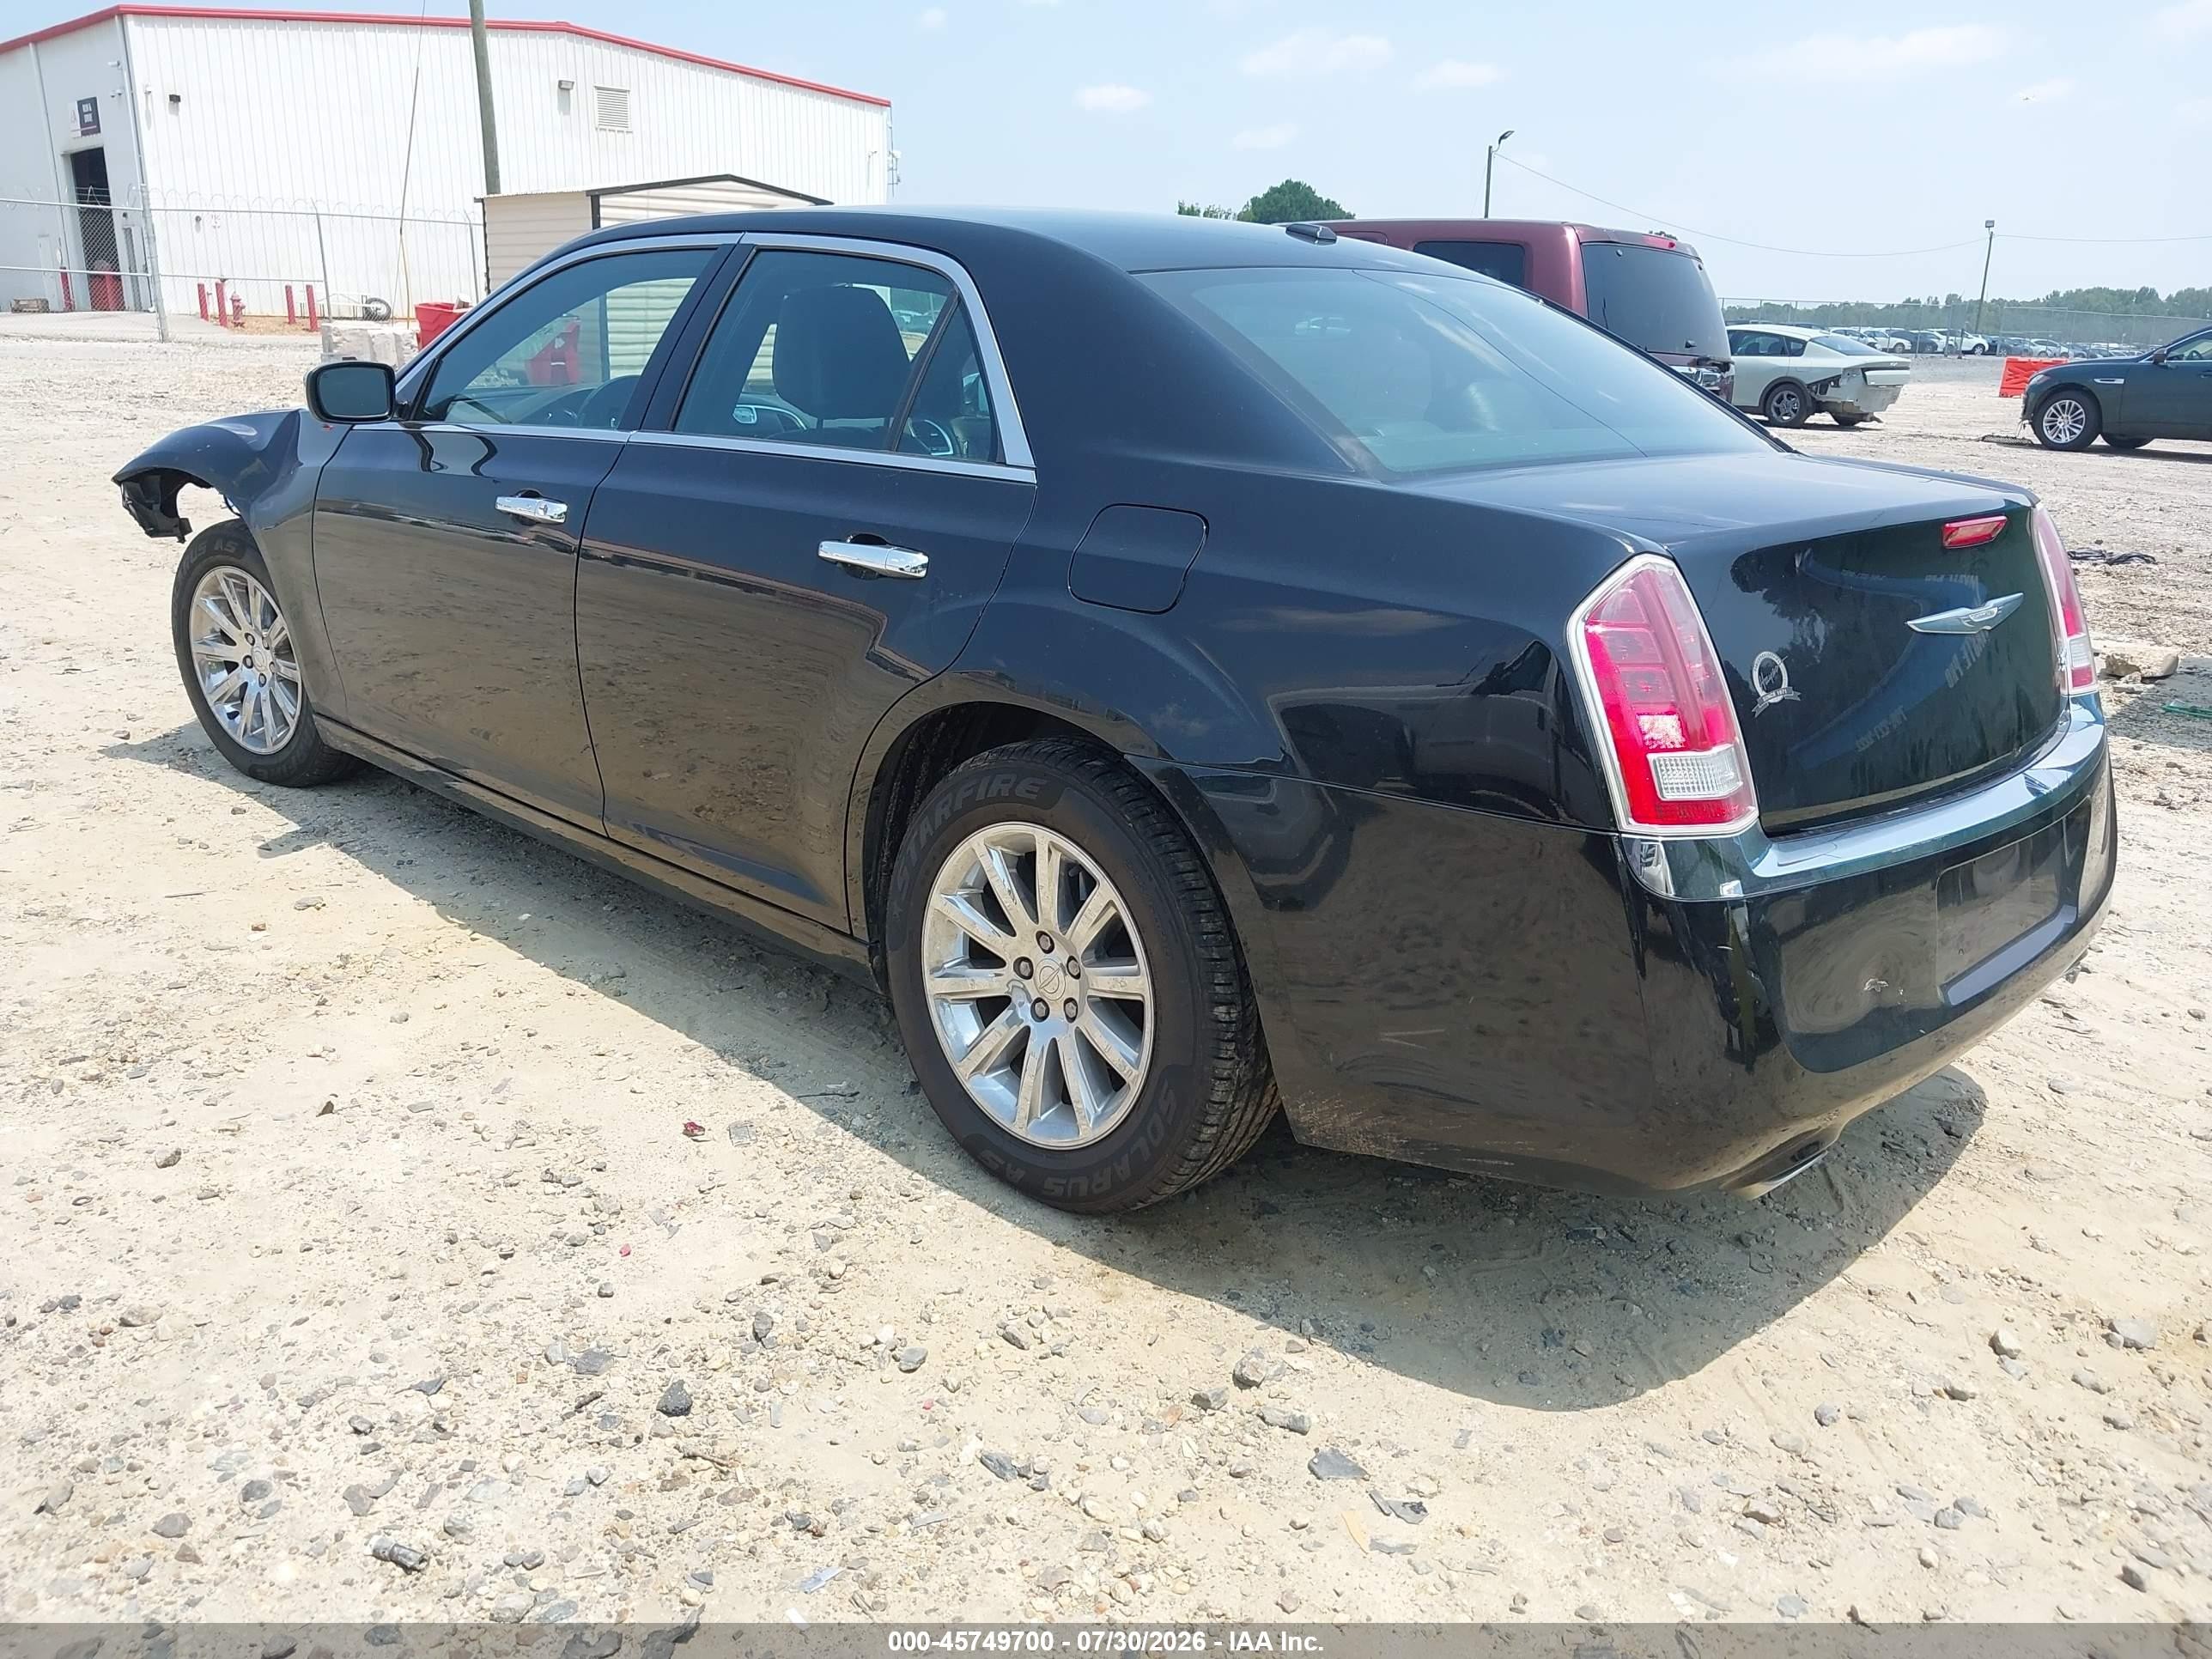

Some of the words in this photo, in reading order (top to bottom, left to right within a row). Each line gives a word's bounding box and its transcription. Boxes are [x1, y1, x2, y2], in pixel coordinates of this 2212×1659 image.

[896, 773, 1048, 898] STARFIRE
[978, 1150, 1026, 1183] AS
[1043, 1079, 1178, 1197] SOLARUS
